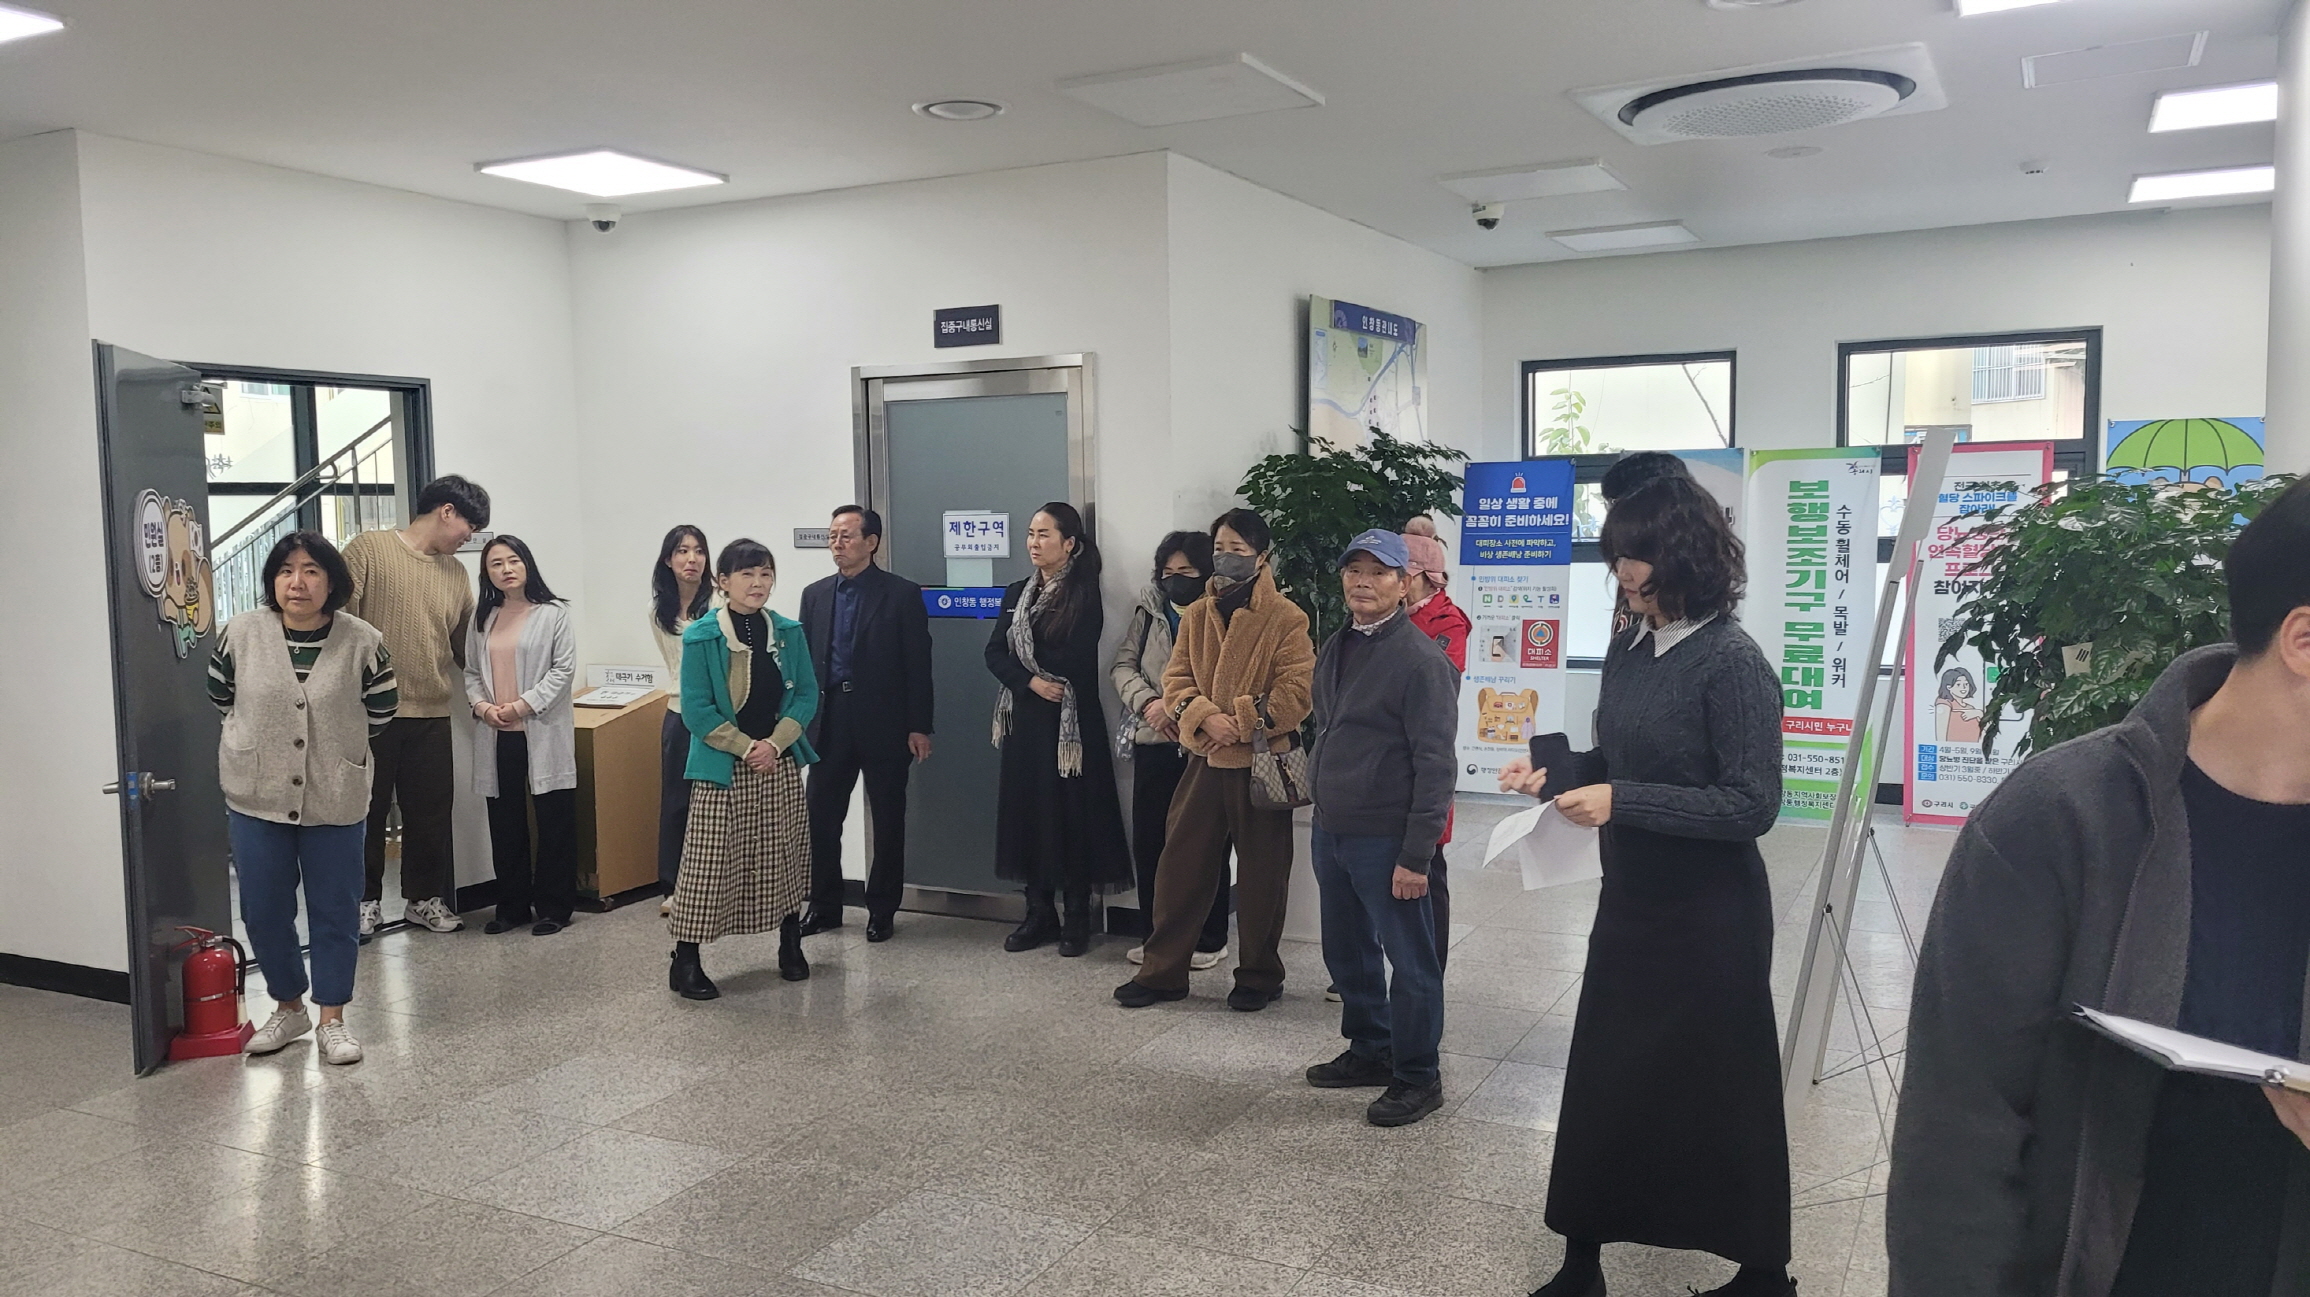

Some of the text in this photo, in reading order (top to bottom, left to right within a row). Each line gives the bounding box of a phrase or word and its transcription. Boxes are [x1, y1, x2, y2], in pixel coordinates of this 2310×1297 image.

[941, 318, 992, 333] 집중구내통신실
[1362, 316, 1398, 336] 인창동관내도
[1479, 496, 1558, 510] 일상 생활 중에
[1938, 491, 2018, 503] 혈당 스파이크를
[1465, 513, 1570, 528] 꼼꼼히 준비하세요!
[143, 521, 165, 549] 민원실
[948, 520, 1004, 538] 제한구역
[1475, 538, 1557, 548] 대피장소 사전에 파악하고,
[1783, 480, 1831, 612] 보행보조기구
[1480, 549, 1552, 560] 비상 생존배낭 준비하기
[954, 597, 977, 608] 인창동
[1832, 606, 1849, 636] 목발
[1527, 648, 1552, 656] 대피소
[1781, 621, 1826, 711] 무료대여
[615, 672, 633, 683] 태극기
[635, 673, 653, 684] 수거함
[1831, 657, 1847, 689] 워커
[1785, 720, 1823, 731] 구리시민
[1920, 745, 1935, 753] 기간
[1939, 755, 1960, 763] 당뇨병
[1961, 756, 1983, 765] 진단을
[1939, 764, 1961, 773] 상반기
[1938, 773, 1956, 781] 031)
